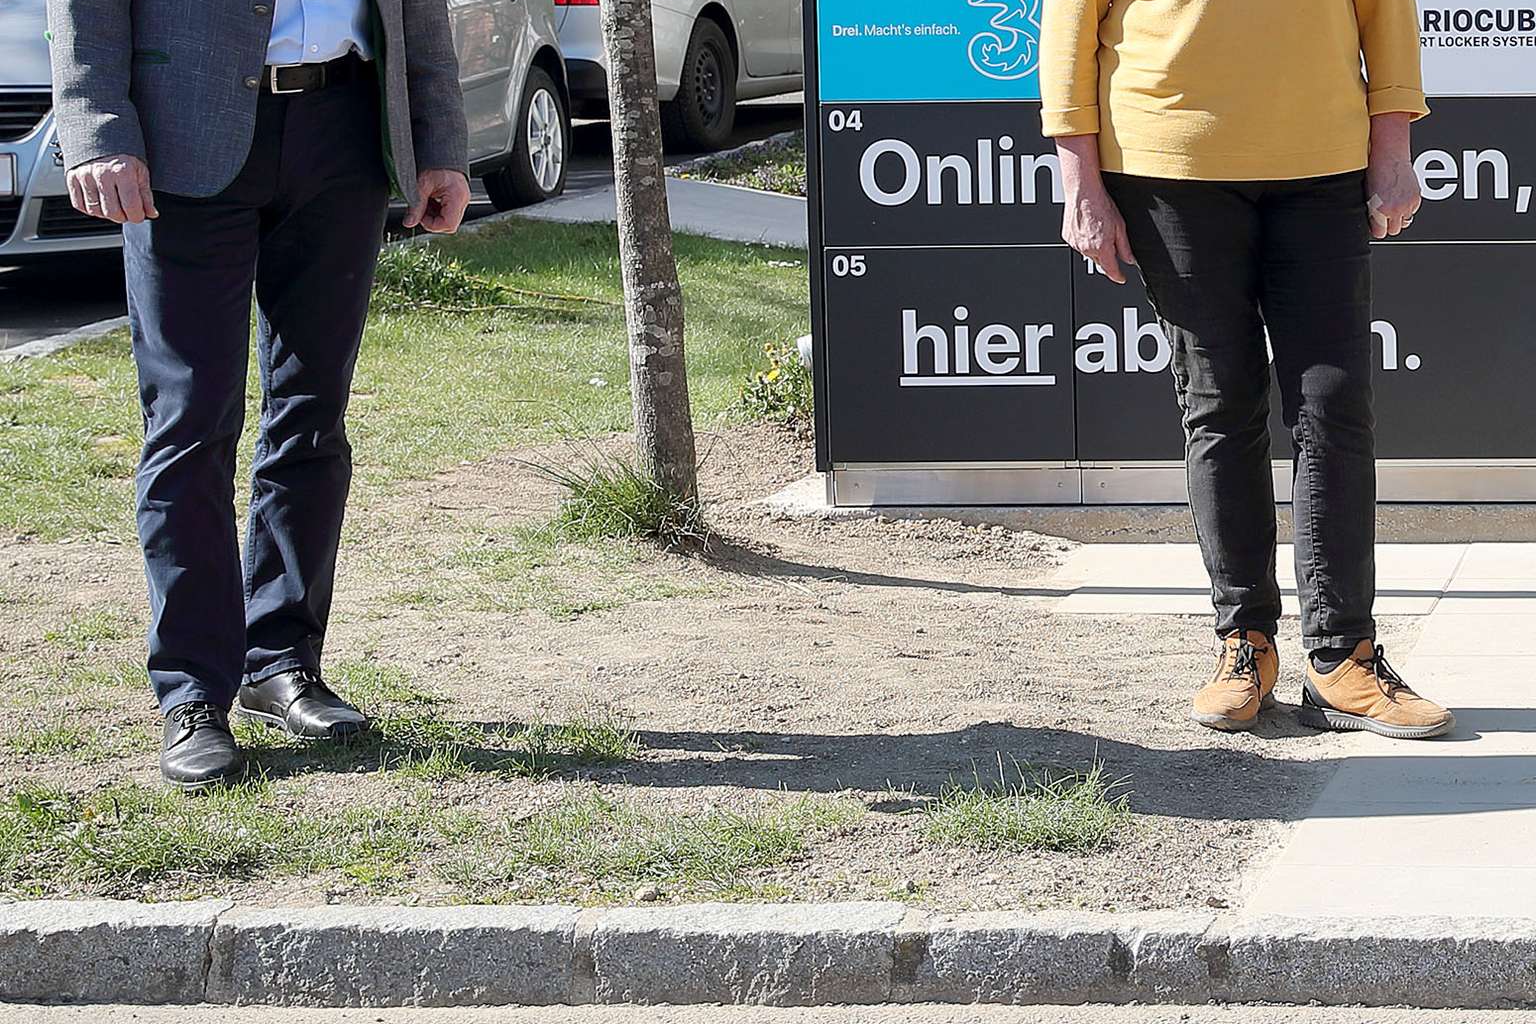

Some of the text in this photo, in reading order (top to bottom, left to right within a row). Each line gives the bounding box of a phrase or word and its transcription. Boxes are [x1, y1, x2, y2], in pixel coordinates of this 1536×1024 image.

[832, 22, 961, 37] Drei. Macht's einfach.
[1438, 36, 1490, 48] LOCKER
[828, 110, 863, 132] 04
[859, 135, 1066, 206] Onlin
[832, 255, 867, 277] 05
[902, 306, 1055, 376] hier
